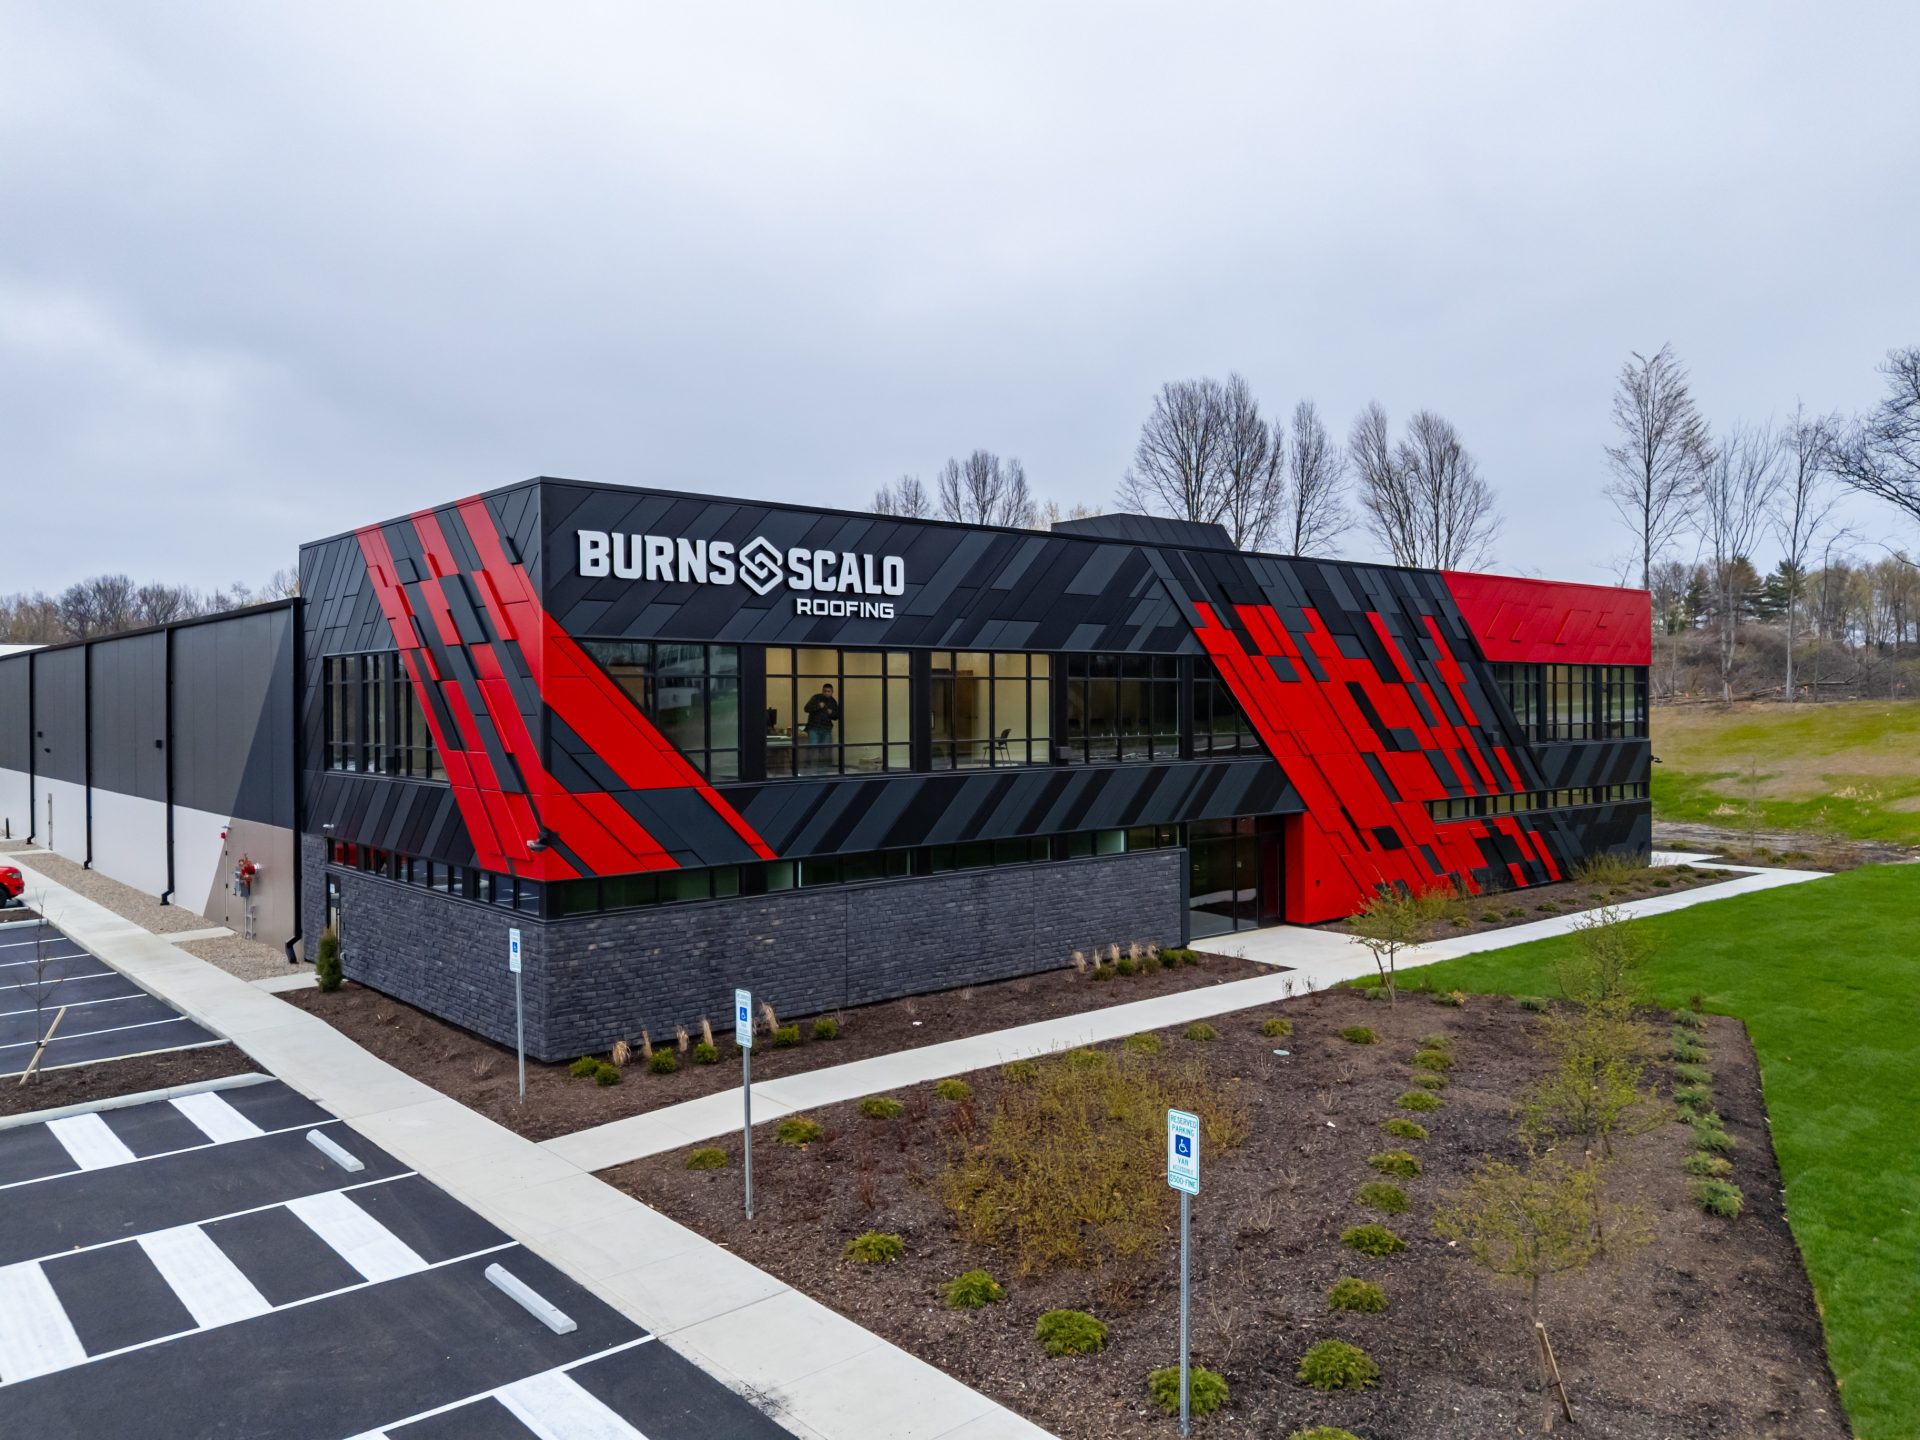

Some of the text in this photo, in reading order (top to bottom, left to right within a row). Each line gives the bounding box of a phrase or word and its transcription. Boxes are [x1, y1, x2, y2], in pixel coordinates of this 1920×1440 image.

[577, 529, 905, 596] BURNS SCALO
[796, 598, 894, 619] ROOFING
[1170, 1114, 1197, 1129] RESERVED
[1172, 1124, 1195, 1137] PARKING
[1178, 1157, 1189, 1166] VAN
